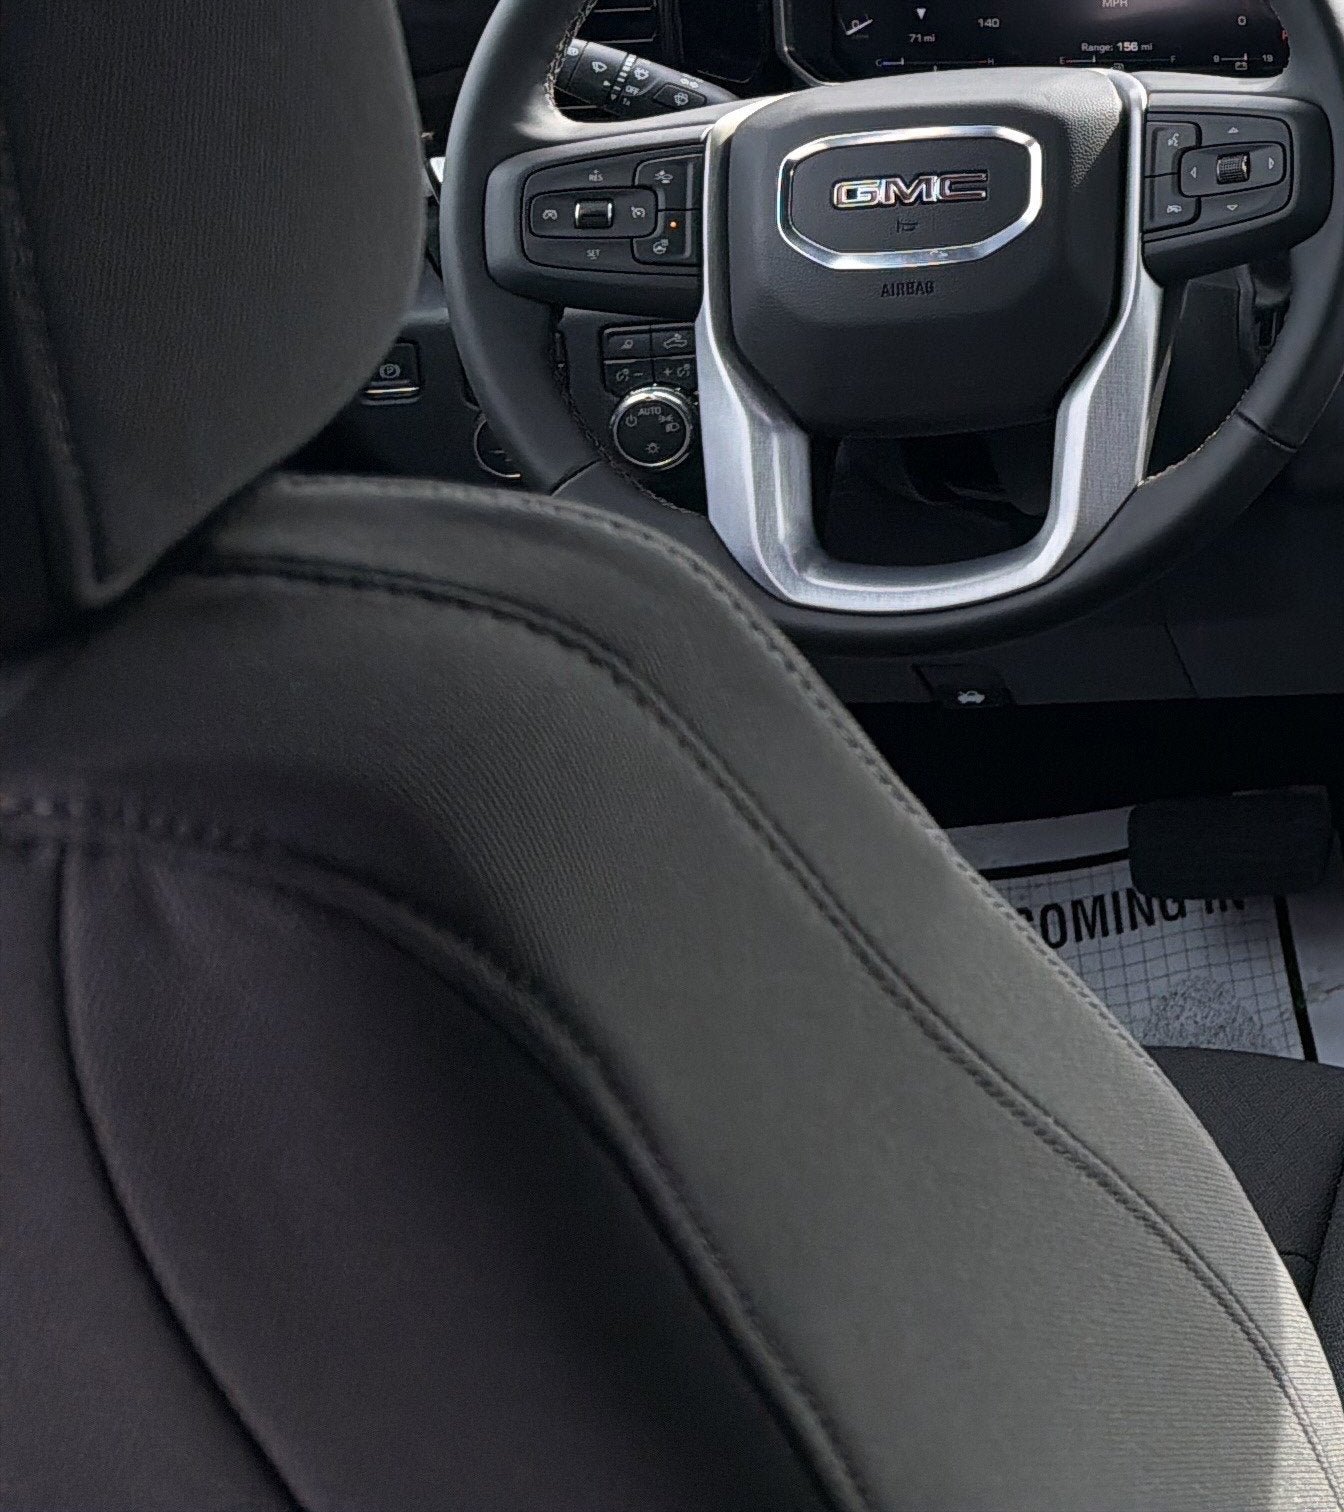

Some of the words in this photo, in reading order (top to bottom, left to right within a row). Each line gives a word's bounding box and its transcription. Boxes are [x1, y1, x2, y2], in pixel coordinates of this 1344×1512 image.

[977, 18, 1000, 28] 140
[910, 34, 922, 43] 71
[924, 34, 936, 42] mi
[1081, 43, 1113, 54] Range:
[1141, 42, 1153, 51] mi
[588, 174, 604, 182] RES
[833, 172, 989, 209] GMC
[880, 279, 935, 298] AIRBAG
[637, 406, 662, 417] AUTO
